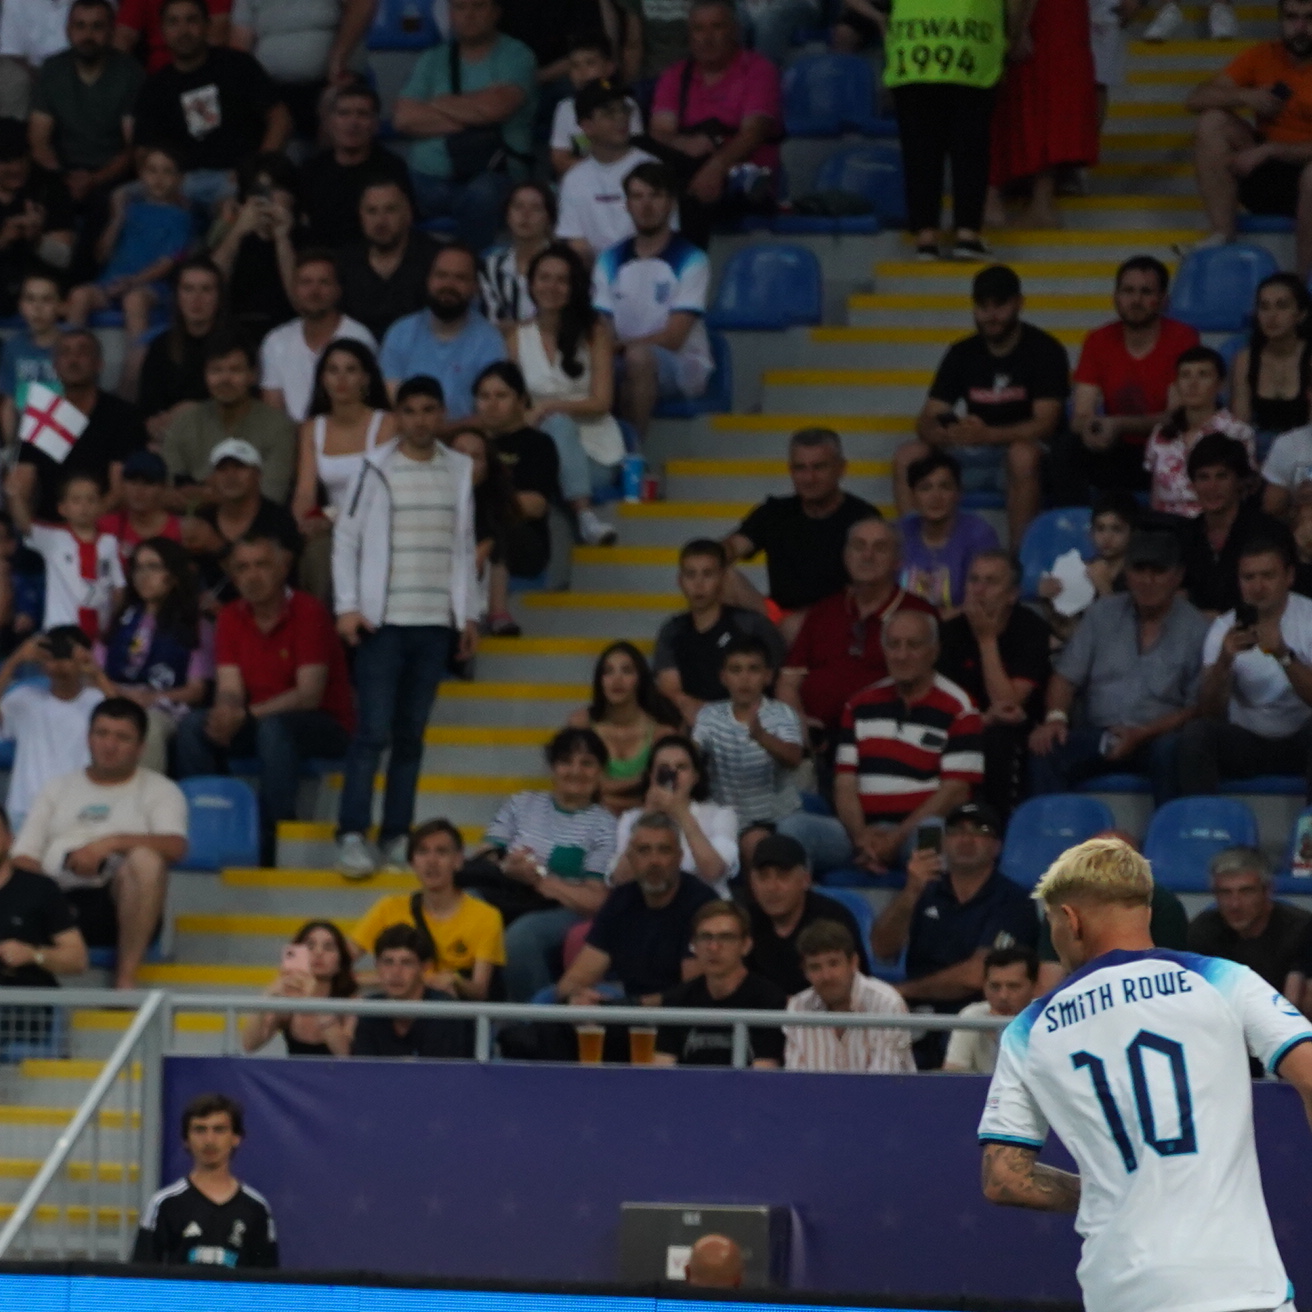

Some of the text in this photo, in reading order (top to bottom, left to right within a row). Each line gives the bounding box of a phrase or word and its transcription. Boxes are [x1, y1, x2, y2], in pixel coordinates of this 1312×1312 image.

[896, 44, 976, 76] 1994
[1045, 970, 1193, 1034] SMITH ROWE
[1069, 1028, 1199, 1175] 10
